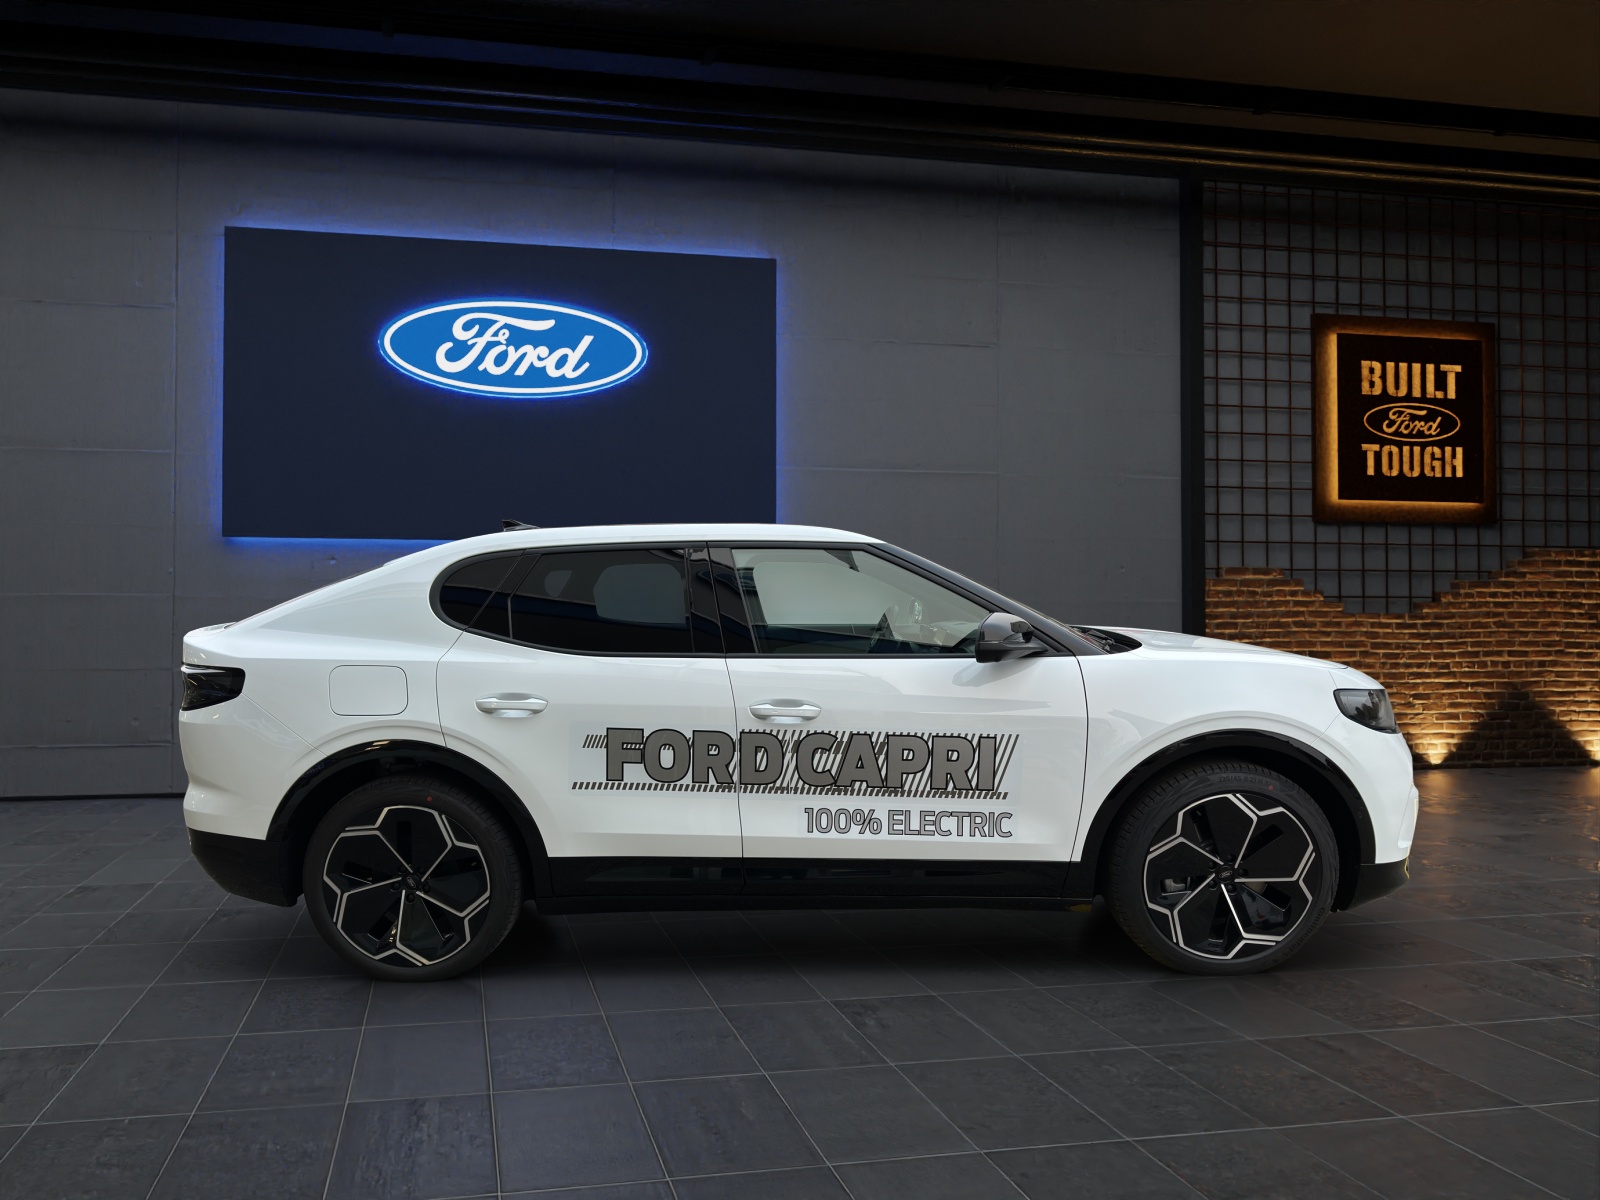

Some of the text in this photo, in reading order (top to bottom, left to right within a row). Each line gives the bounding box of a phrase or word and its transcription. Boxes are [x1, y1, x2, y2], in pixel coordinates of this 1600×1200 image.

[435, 312, 595, 379] Ford
[1360, 360, 1462, 399] BUILT
[1382, 407, 1442, 436] Ford
[1361, 443, 1463, 478] TOUGH
[605, 728, 997, 791] FORD CAPRI
[804, 807, 1014, 838] 100% ELECTRIC
